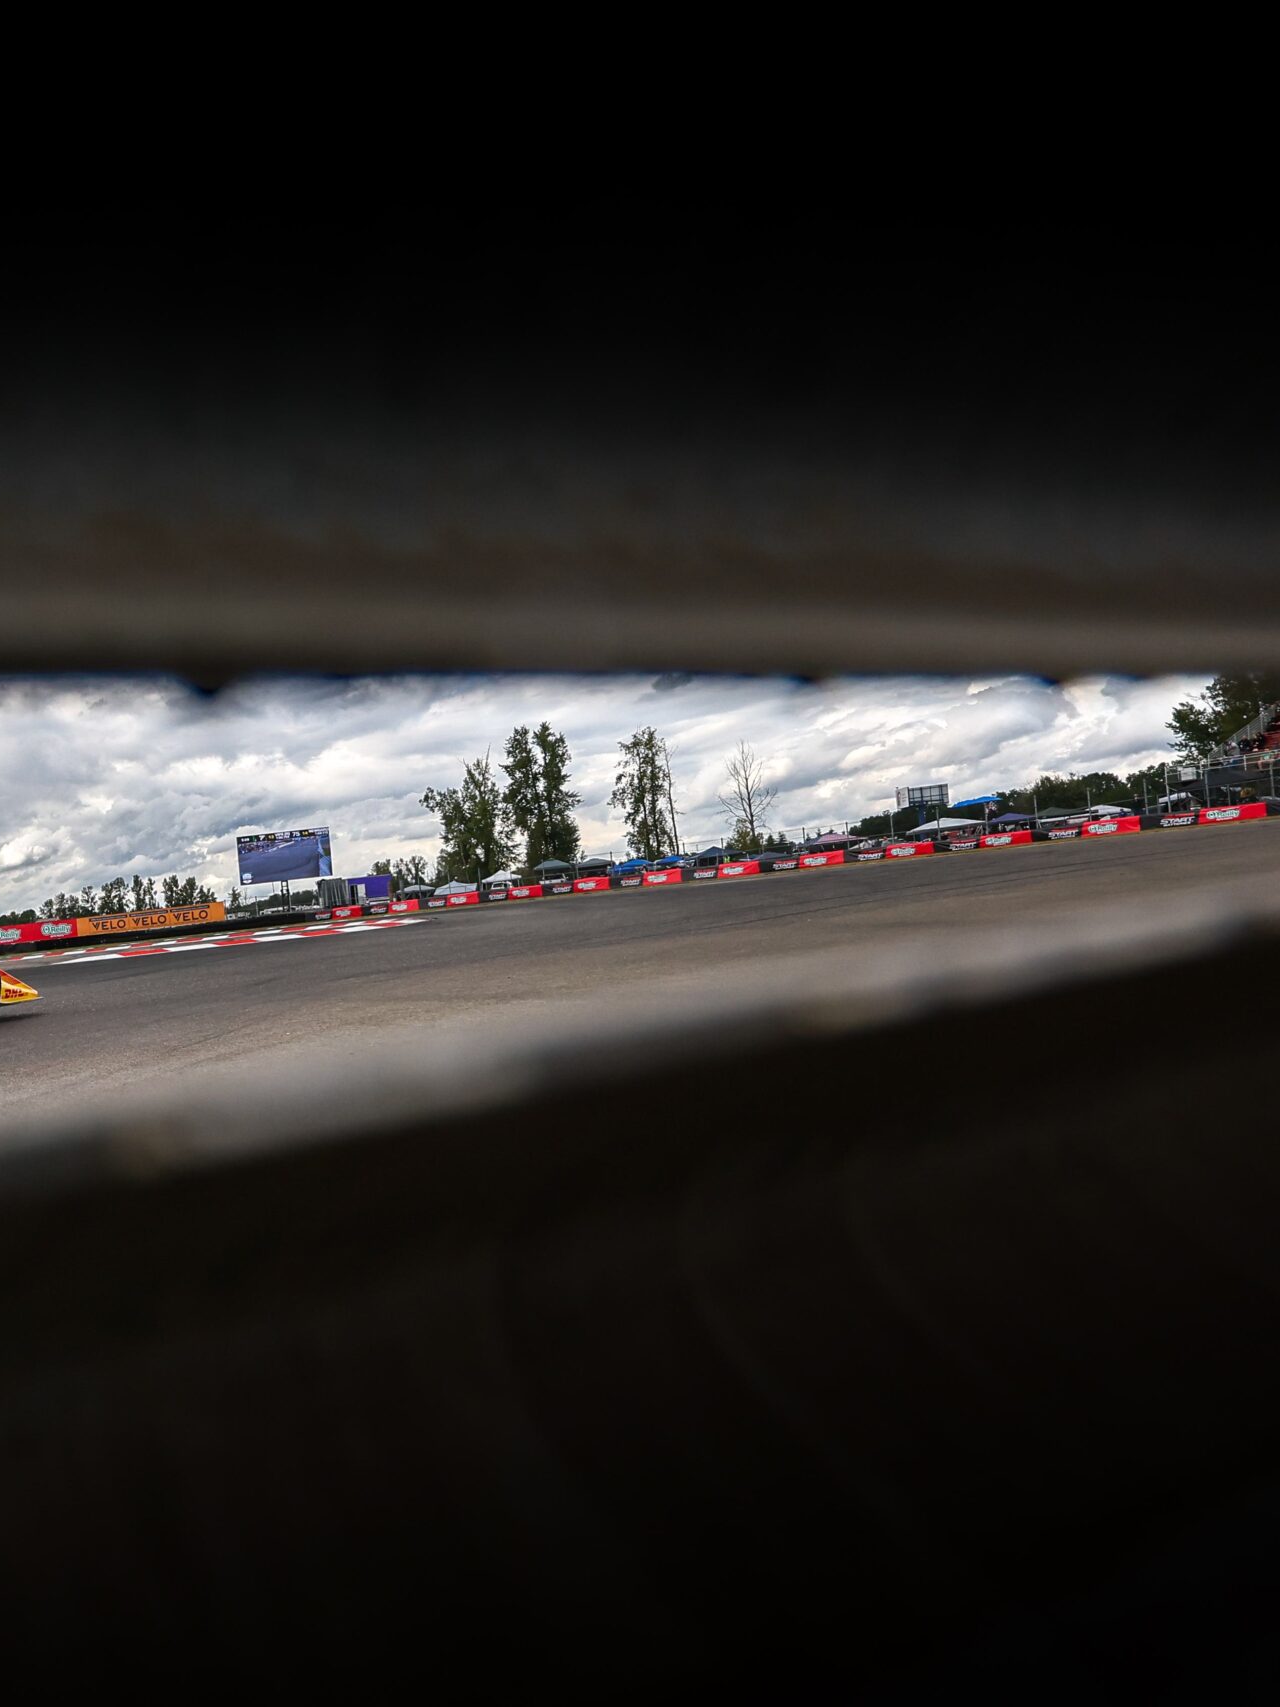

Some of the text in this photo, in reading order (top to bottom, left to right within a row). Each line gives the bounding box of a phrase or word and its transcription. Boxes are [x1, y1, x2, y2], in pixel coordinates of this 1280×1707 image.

[132, 915, 167, 927] VELO
[173, 910, 208, 921] VELO
[92, 919, 126, 930] VELO
[4, 988, 24, 999] DHL
